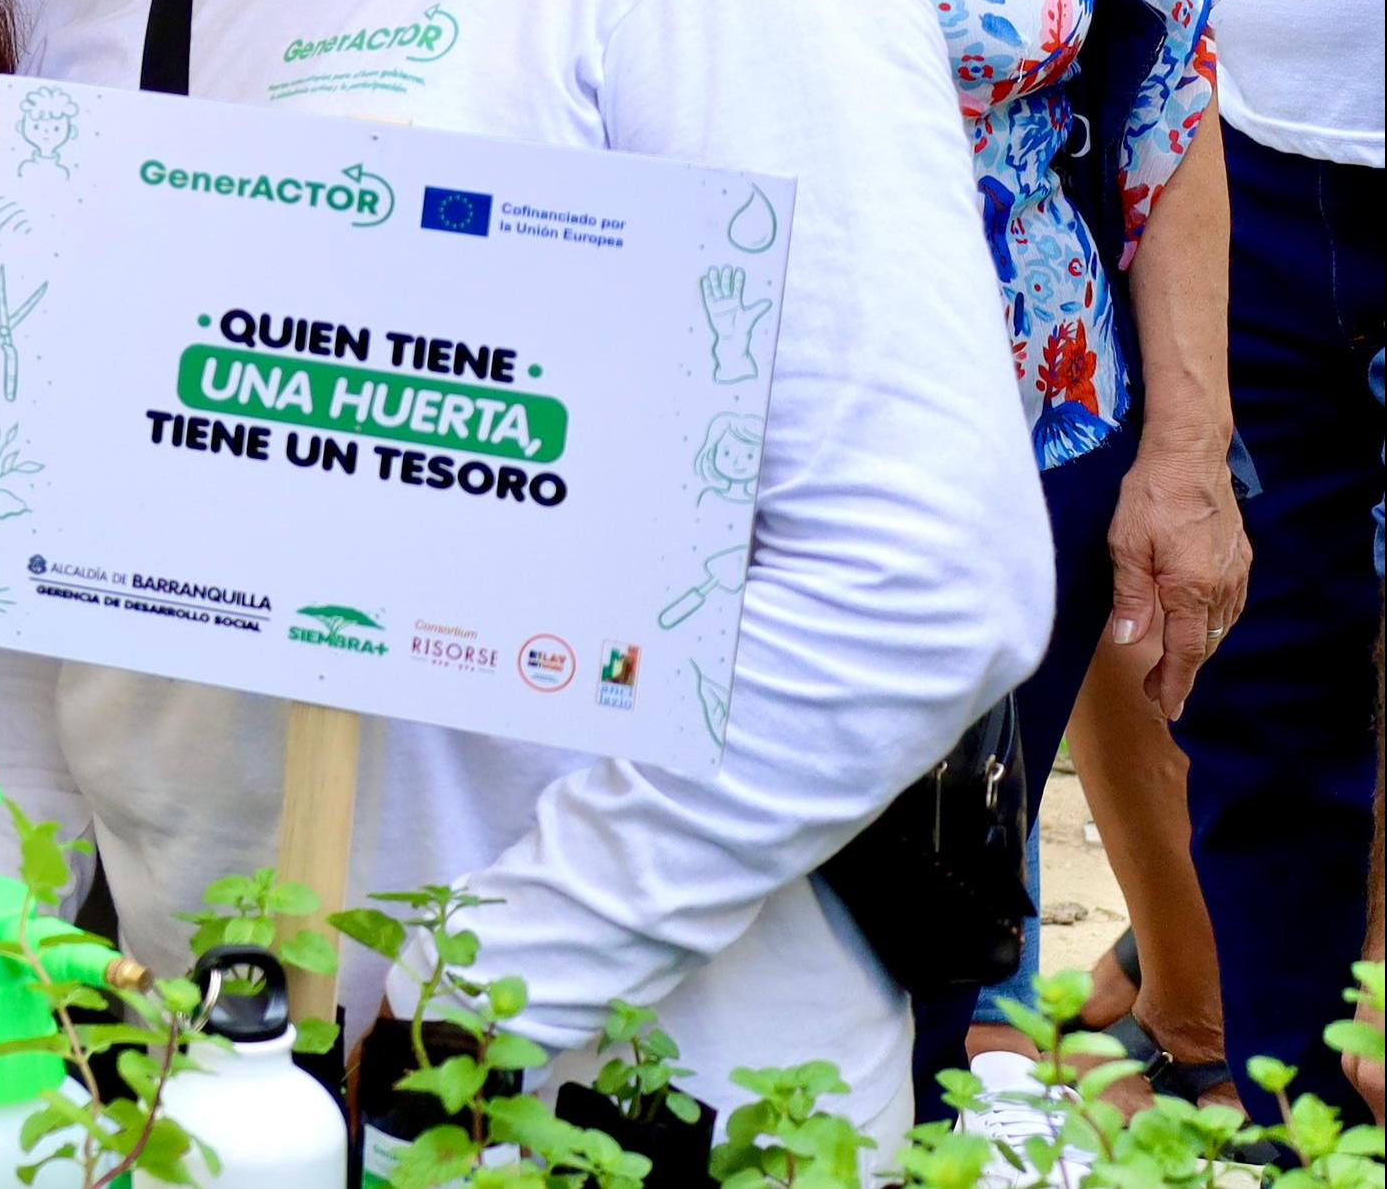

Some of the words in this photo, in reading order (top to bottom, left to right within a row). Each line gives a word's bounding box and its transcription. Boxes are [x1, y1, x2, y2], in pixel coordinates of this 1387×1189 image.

[283, 23, 443, 62] GenerACTOR
[139, 159, 380, 216] GenerACTOR
[498, 220, 512, 234] la
[515, 222, 559, 240] Unión
[563, 228, 625, 250] Europea
[500, 202, 596, 227] Cofinanciado
[600, 216, 627, 232] por
[220, 309, 370, 362] QUIEN
[386, 332, 516, 383] TIENE
[201, 356, 313, 415] UNA
[329, 376, 542, 458] HUERTA,
[146, 410, 271, 460] TIENE
[286, 432, 358, 475] UN
[374, 445, 567, 507] TESORO
[36, 585, 100, 604] GERENCIA
[104, 595, 120, 608] DE
[124, 600, 210, 623] DESARROLLO
[214, 614, 261, 632] SOCIAL
[51, 562, 108, 582] ALCALDÍA
[112, 573, 126, 586] DE
[132, 573, 272, 611] BARRANQUILLA
[288, 625, 389, 656] SIEMBRA+
[411, 636, 499, 667] RISORSE
